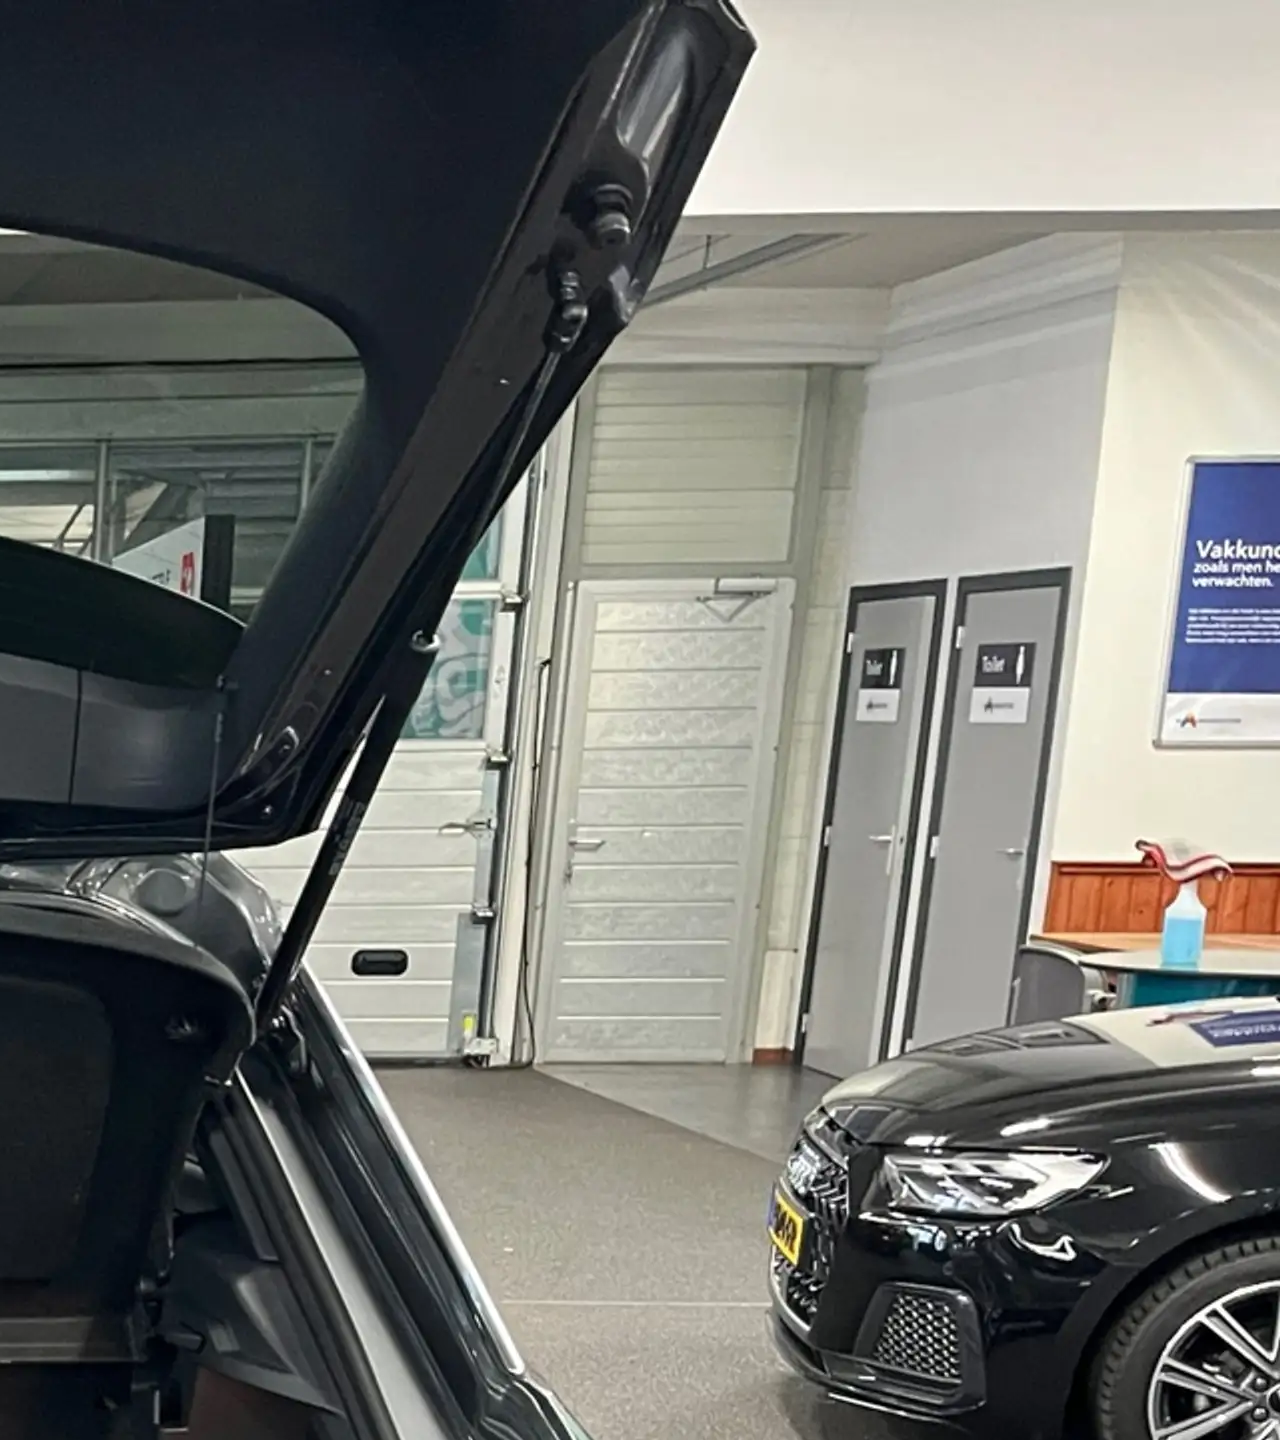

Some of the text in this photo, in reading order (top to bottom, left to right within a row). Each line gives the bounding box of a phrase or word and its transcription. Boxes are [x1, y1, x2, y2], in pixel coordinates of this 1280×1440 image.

[1193, 560, 1229, 574] zoals
[1231, 562, 1262, 574] men
[1191, 574, 1274, 588] verwachten.
